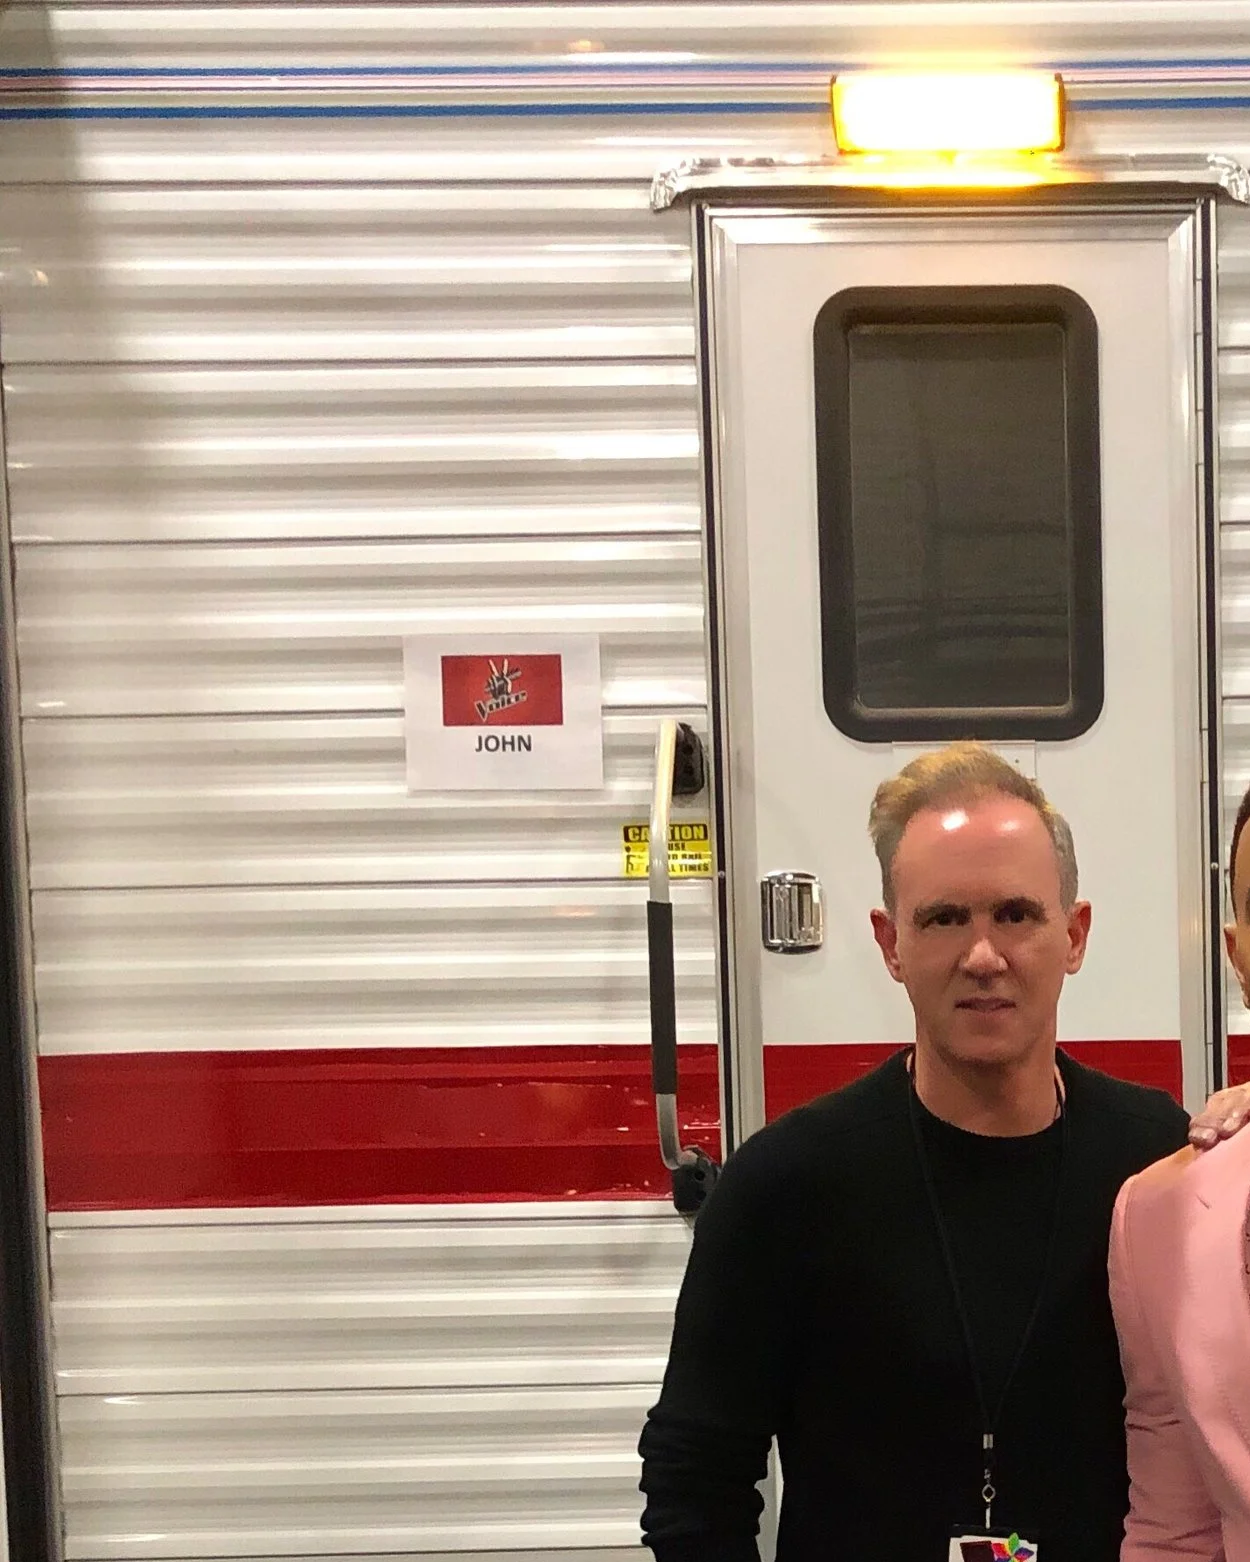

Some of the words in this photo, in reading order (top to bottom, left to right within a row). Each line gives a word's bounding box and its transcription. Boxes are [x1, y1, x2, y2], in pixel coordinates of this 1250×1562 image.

[475, 734, 532, 752] JOHN
[628, 825, 705, 841] CATION
[679, 863, 709, 872] TIMES
